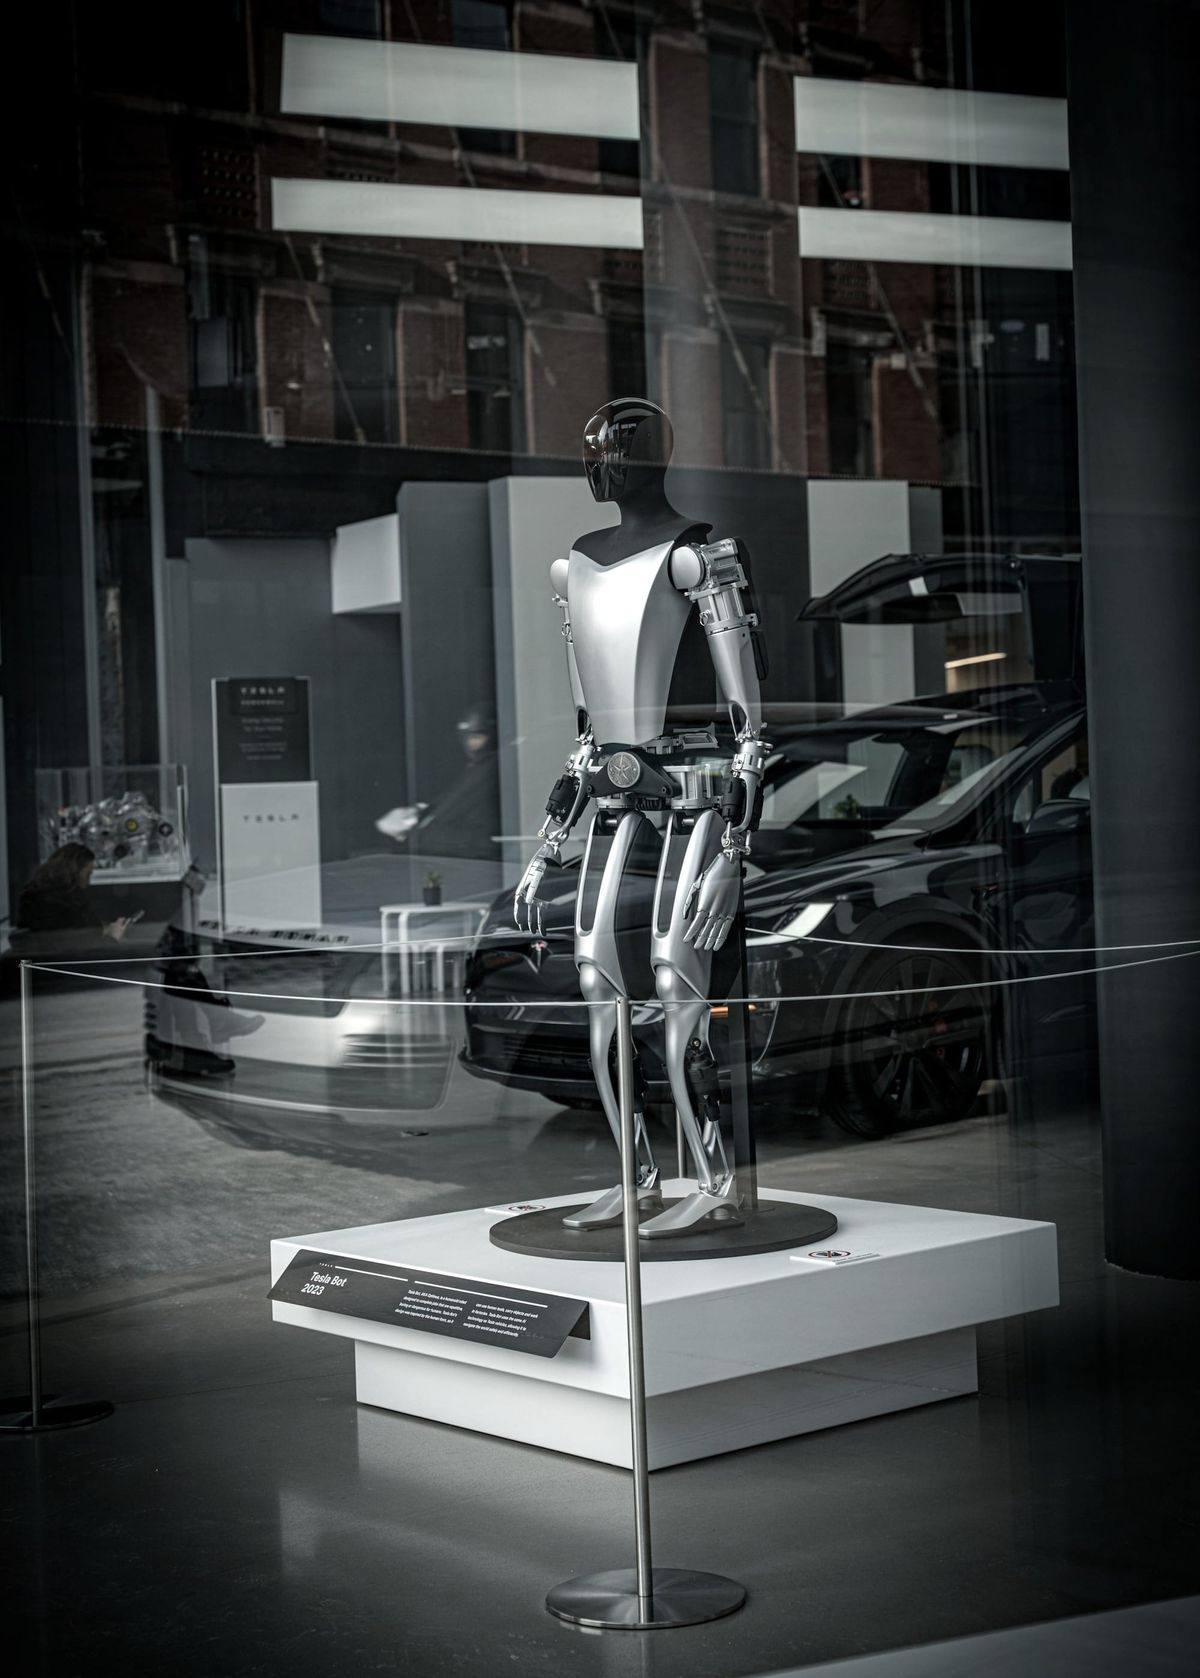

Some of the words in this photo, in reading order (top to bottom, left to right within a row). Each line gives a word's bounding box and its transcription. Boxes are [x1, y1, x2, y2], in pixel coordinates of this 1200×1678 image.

[240, 686, 285, 695] TESLA
[243, 814, 299, 823] TESLA
[311, 1272, 332, 1284] Tesla
[330, 1276, 348, 1287] Bot
[301, 1283, 325, 1295] 2023
